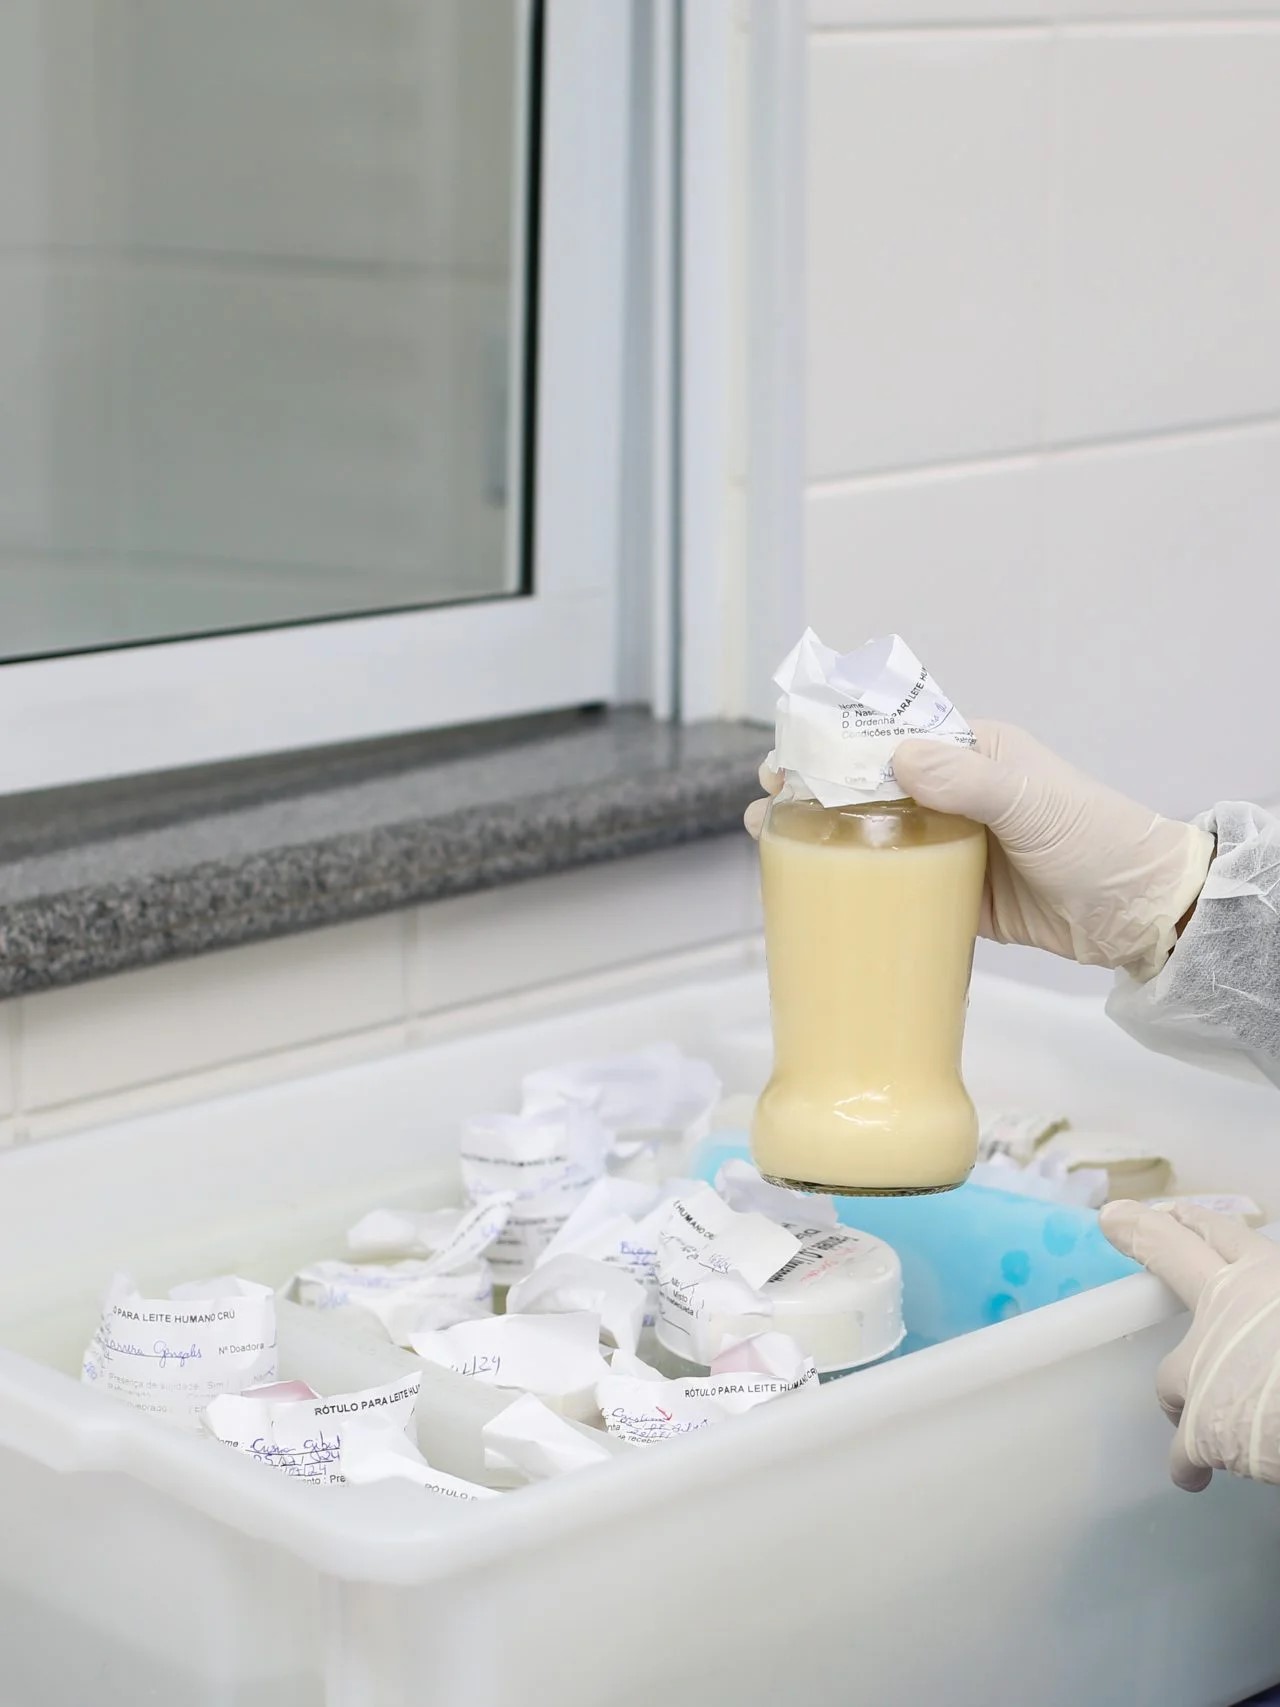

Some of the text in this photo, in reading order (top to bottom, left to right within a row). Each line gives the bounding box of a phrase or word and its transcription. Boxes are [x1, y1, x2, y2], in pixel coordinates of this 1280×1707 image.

[855, 715, 895, 728] Ordenha
[893, 727, 905, 736] de
[117, 1308, 140, 1321] PARA
[142, 1313, 171, 1323] LEITE
[174, 1313, 216, 1324] HUMANO
[230, 1342, 265, 1353] Doadora
[685, 1387, 716, 1398] RÓTULO
[718, 1385, 745, 1395] PARA
[747, 1383, 777, 1393] LEITE
[314, 1402, 358, 1416] RÓTULO
[361, 1398, 388, 1410] PARA
